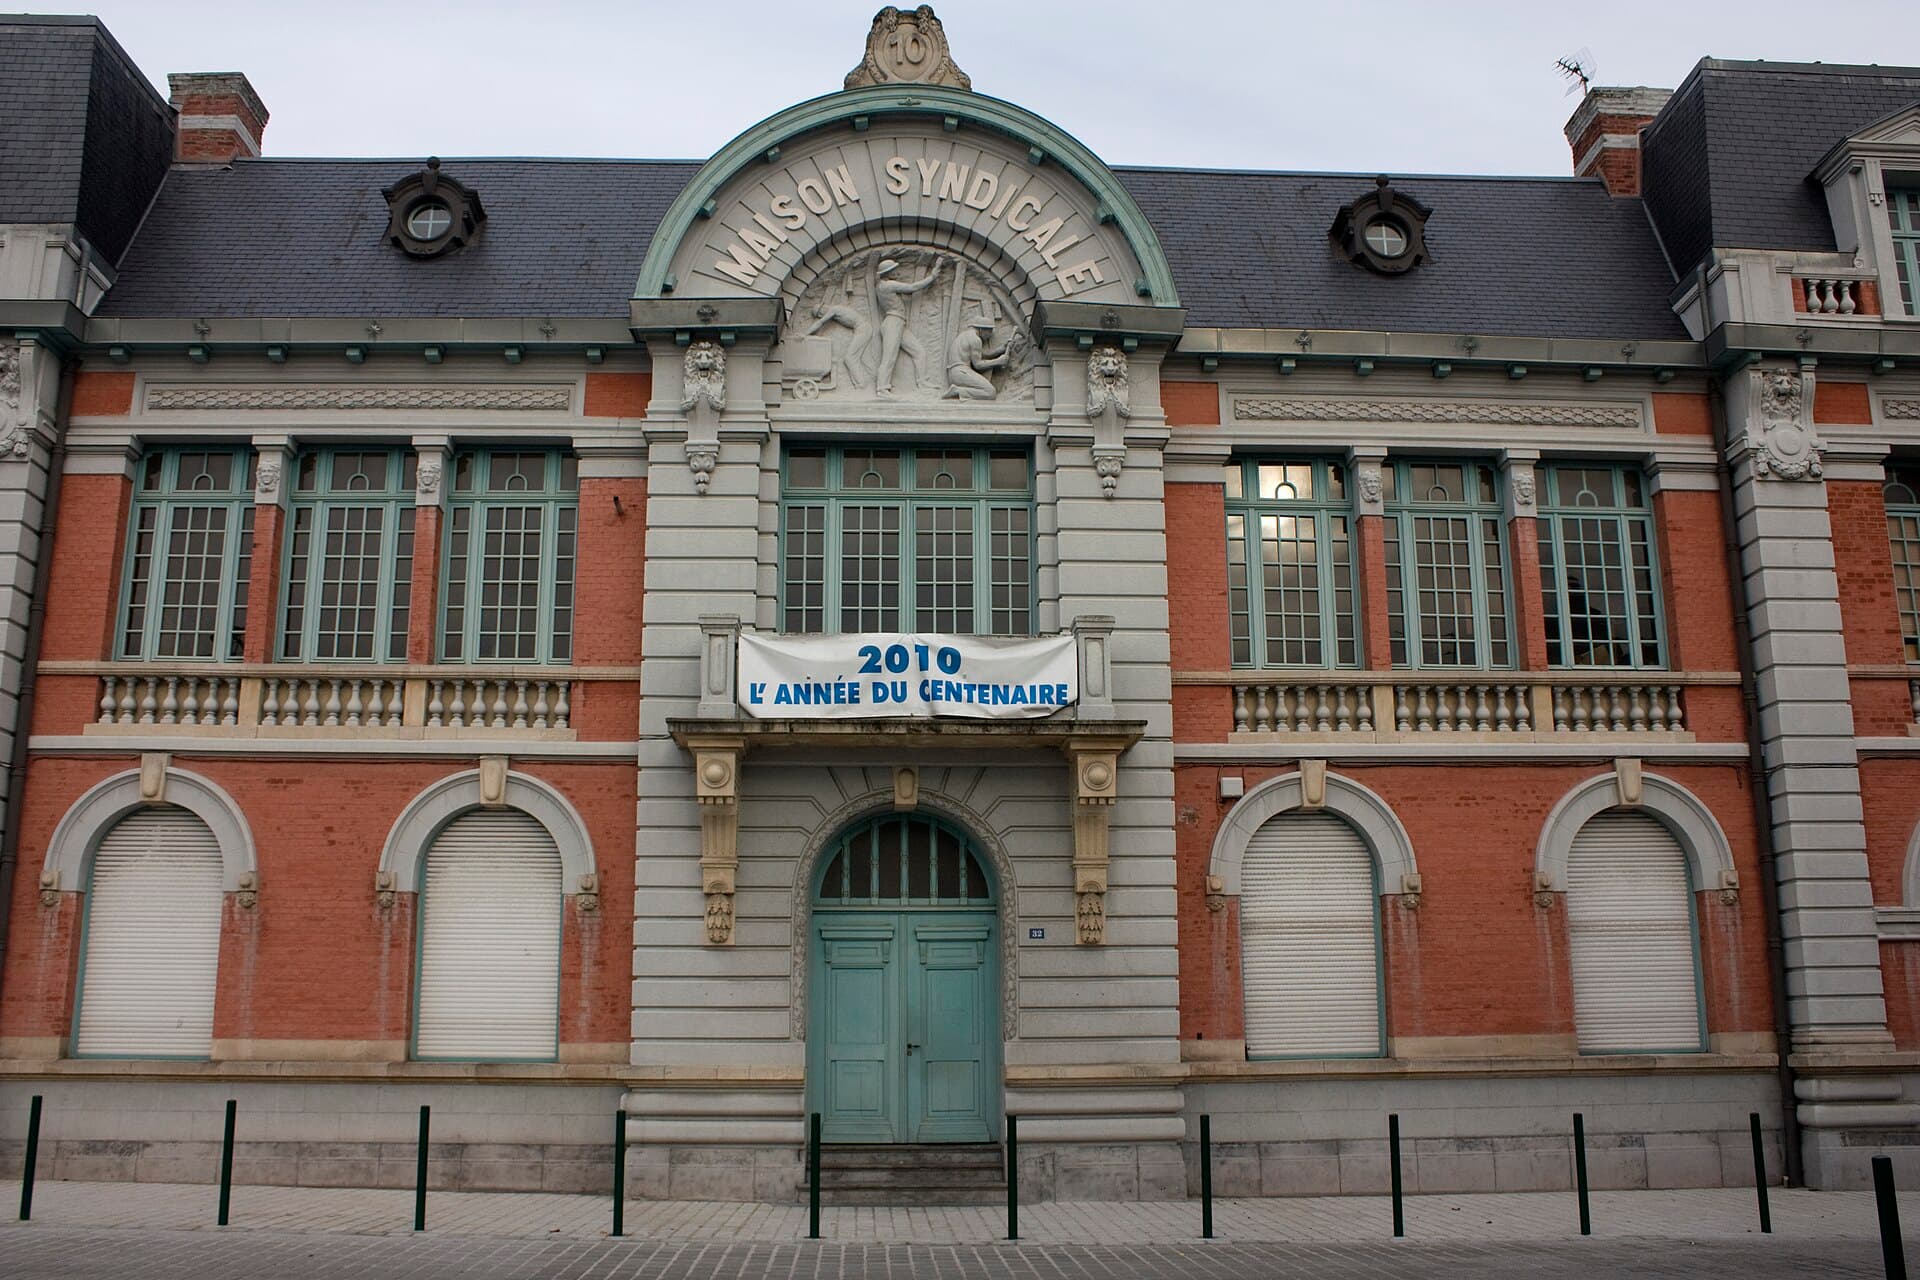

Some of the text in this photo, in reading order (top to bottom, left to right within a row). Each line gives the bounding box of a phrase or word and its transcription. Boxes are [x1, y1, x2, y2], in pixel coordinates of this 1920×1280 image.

[889, 33, 927, 65] 10
[715, 157, 1104, 295] MAISON SYNDICALE
[858, 644, 961, 675] 2010
[774, 676, 860, 705] ANNÉE
[873, 681, 908, 704] DU
[919, 680, 1068, 706] CENTENAIRE
